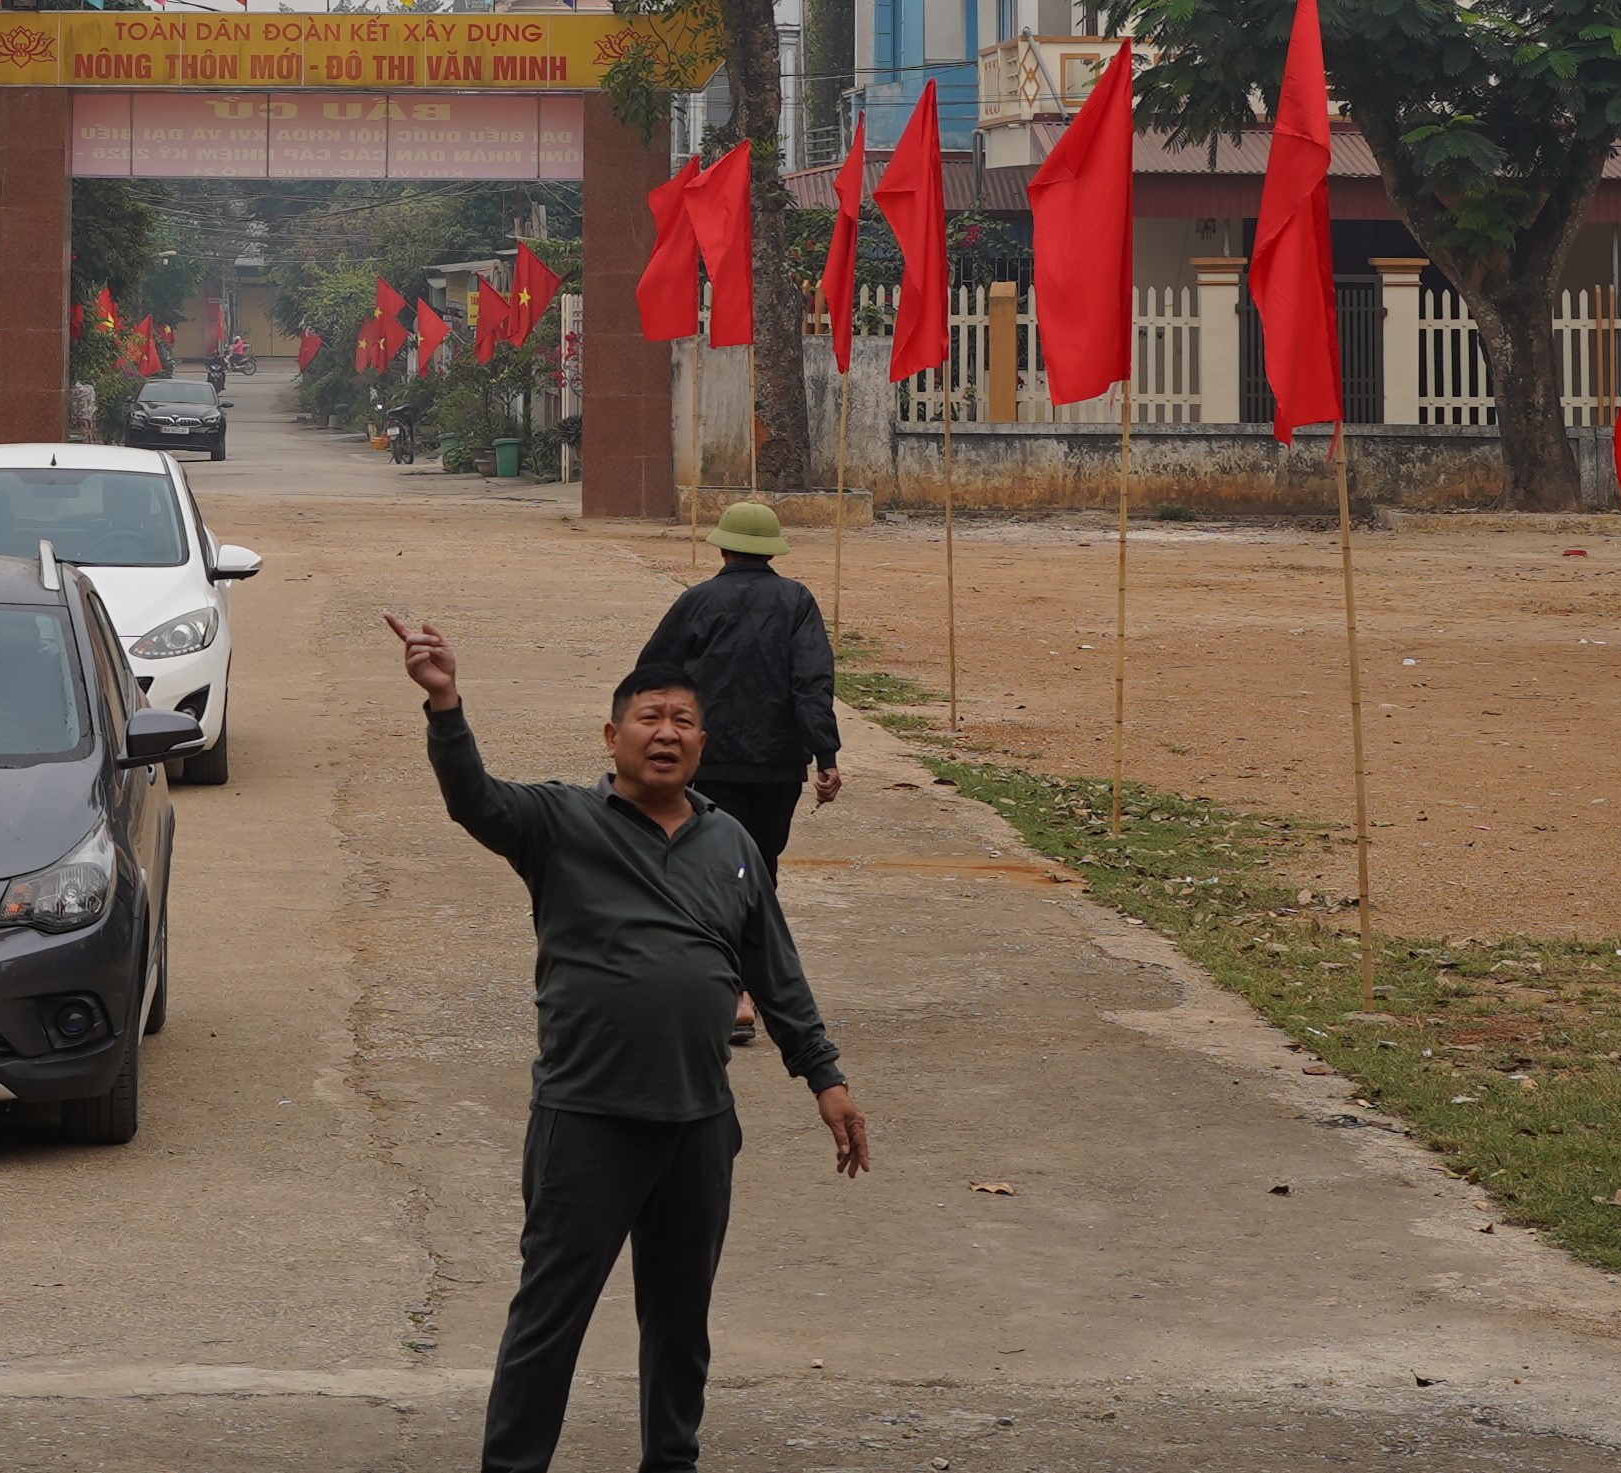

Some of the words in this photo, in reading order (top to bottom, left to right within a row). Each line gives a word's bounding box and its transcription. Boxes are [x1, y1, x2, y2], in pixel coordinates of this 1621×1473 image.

[115, 16, 186, 41] TOÀN
[196, 18, 251, 41] DÂN
[262, 16, 341, 42] ĐOÀN
[350, 15, 390, 42] KẾT
[403, 19, 456, 42] XÂY
[467, 22, 543, 47] DỰNG
[74, 47, 152, 79] NÔNG
[165, 49, 237, 80] THÔN
[250, 47, 303, 80] MỚI
[325, 50, 362, 80] ĐÔ
[372, 56, 415, 85] THỊ
[426, 50, 483, 81] VĂN
[493, 56, 568, 81] MINH
